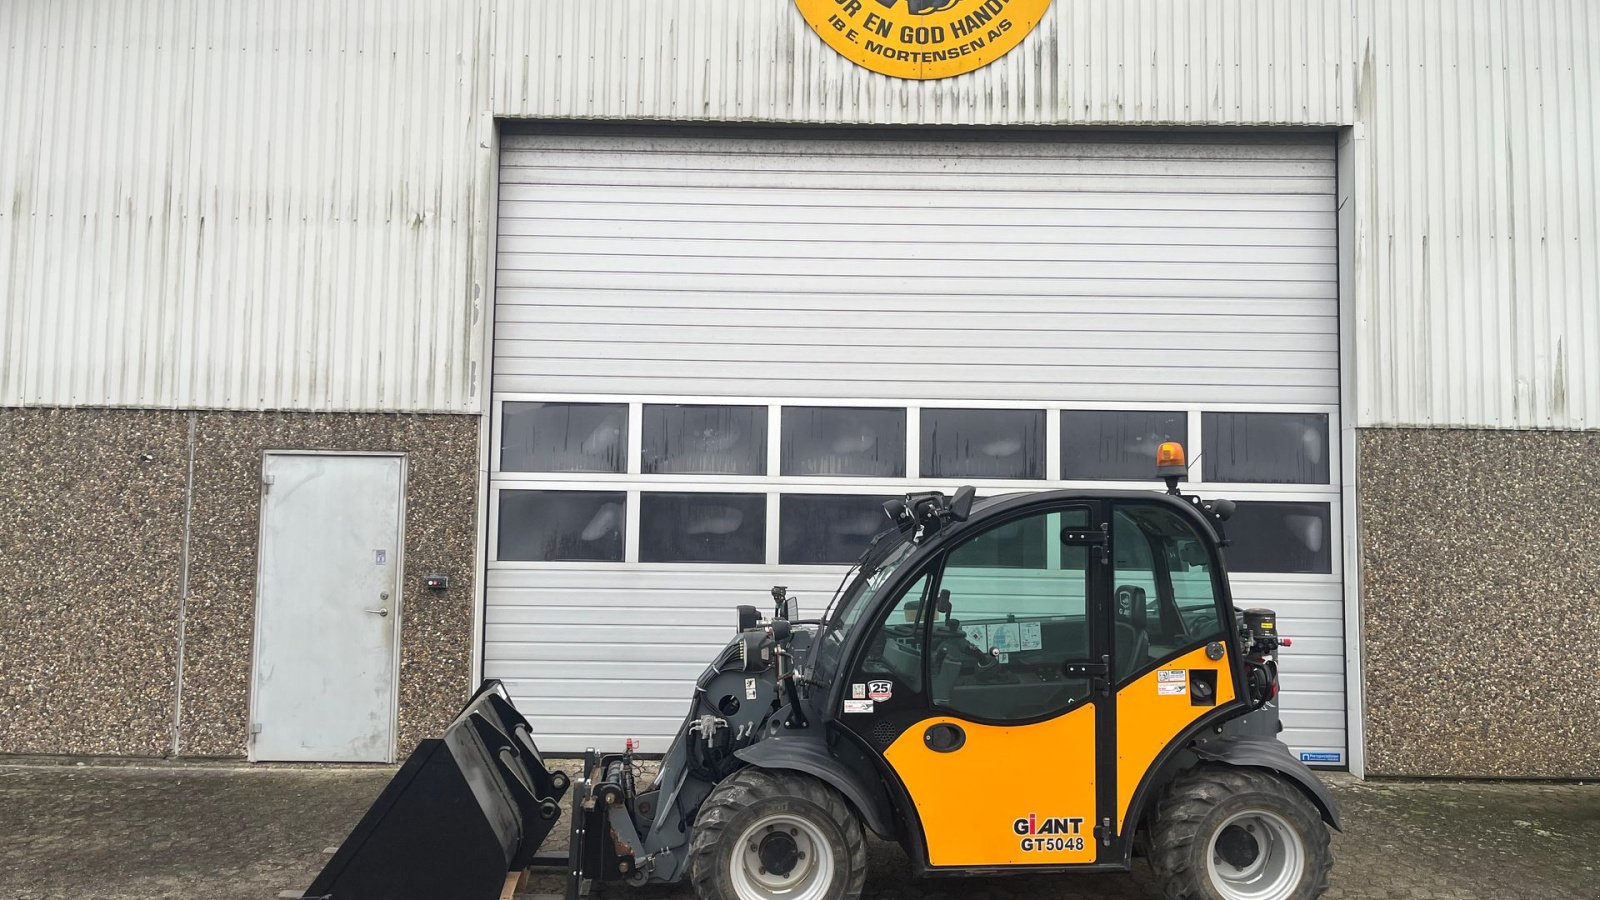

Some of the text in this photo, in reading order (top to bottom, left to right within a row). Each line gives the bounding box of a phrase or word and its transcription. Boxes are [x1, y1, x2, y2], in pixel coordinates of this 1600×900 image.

[834, 0, 1010, 45] R EN GOD HAND
[827, 13, 1013, 63] IB E. MORTENSEN A/S
[872, 683, 888, 693] 25
[1021, 838, 1084, 851] GT5048
